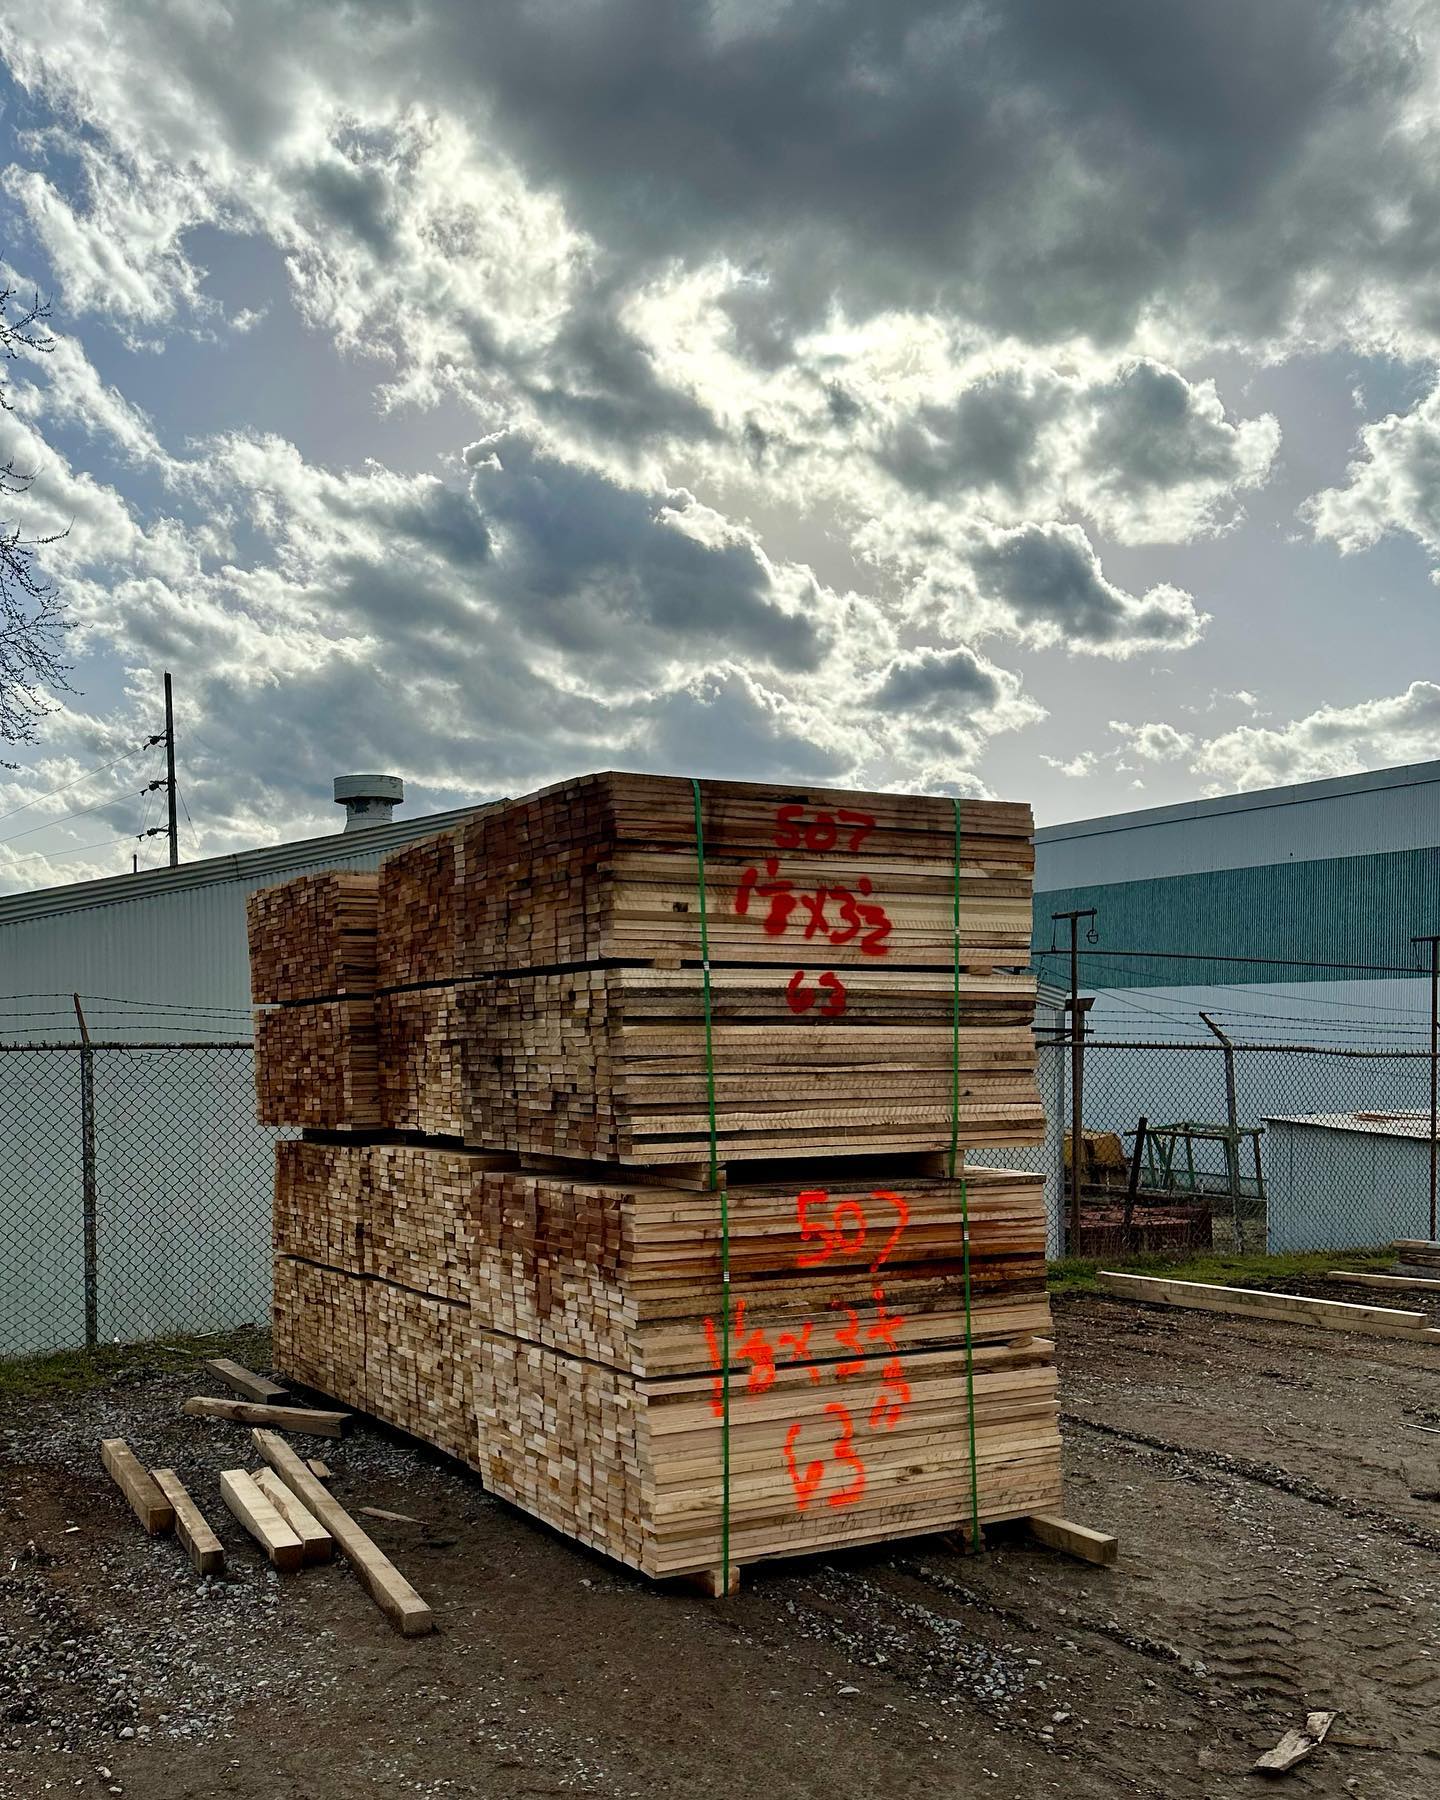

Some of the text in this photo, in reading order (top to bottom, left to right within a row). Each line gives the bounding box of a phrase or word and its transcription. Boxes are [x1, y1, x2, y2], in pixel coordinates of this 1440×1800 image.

[772, 805, 876, 851] 507
[797, 1190, 909, 1273] 507
[784, 1403, 866, 1511] 63
